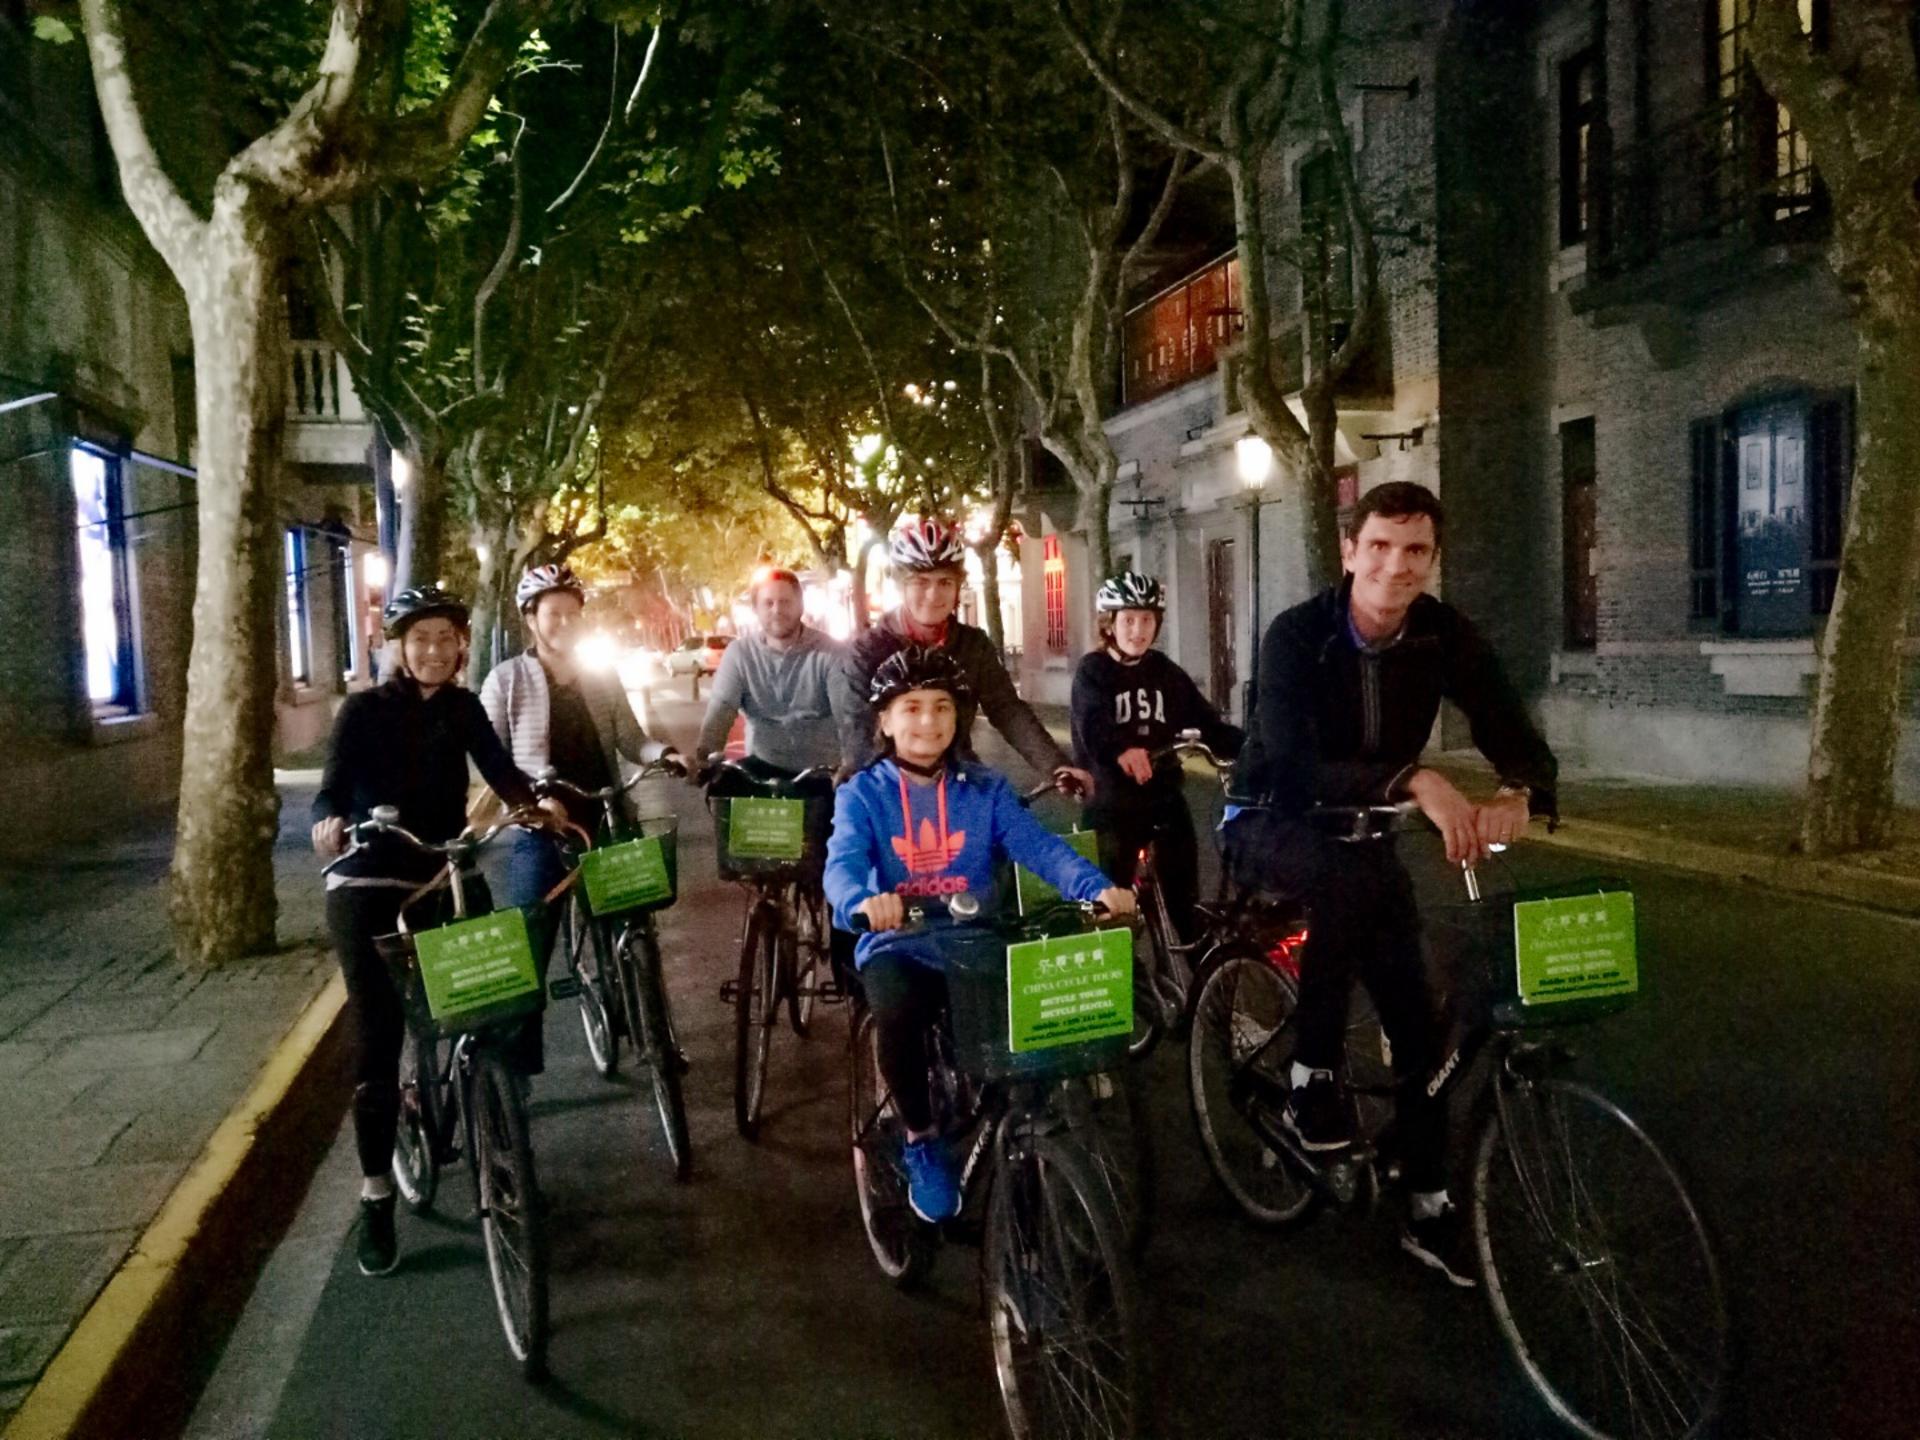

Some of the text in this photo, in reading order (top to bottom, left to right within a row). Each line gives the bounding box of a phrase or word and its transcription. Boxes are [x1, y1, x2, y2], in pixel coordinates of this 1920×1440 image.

[1115, 688, 1166, 724] USA
[895, 875, 968, 896] adidas
[1427, 1049, 1460, 1097] GIANT
